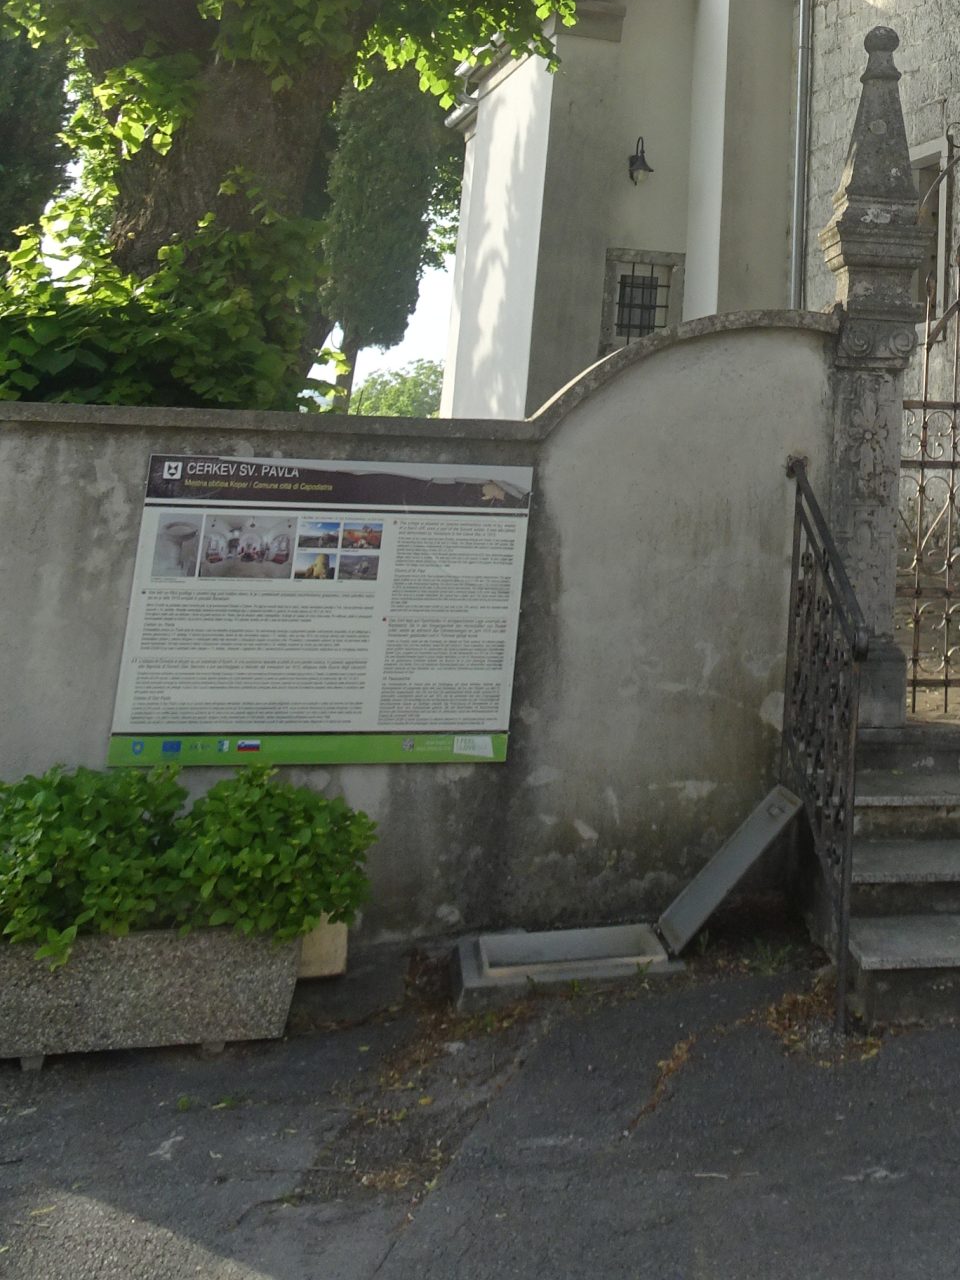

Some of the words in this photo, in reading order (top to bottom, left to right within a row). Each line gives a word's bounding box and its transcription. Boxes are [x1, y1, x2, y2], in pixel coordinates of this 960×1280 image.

[187, 462, 237, 475] CERKEV
[239, 463, 258, 476] SV.
[261, 465, 299, 478] PAVLA
